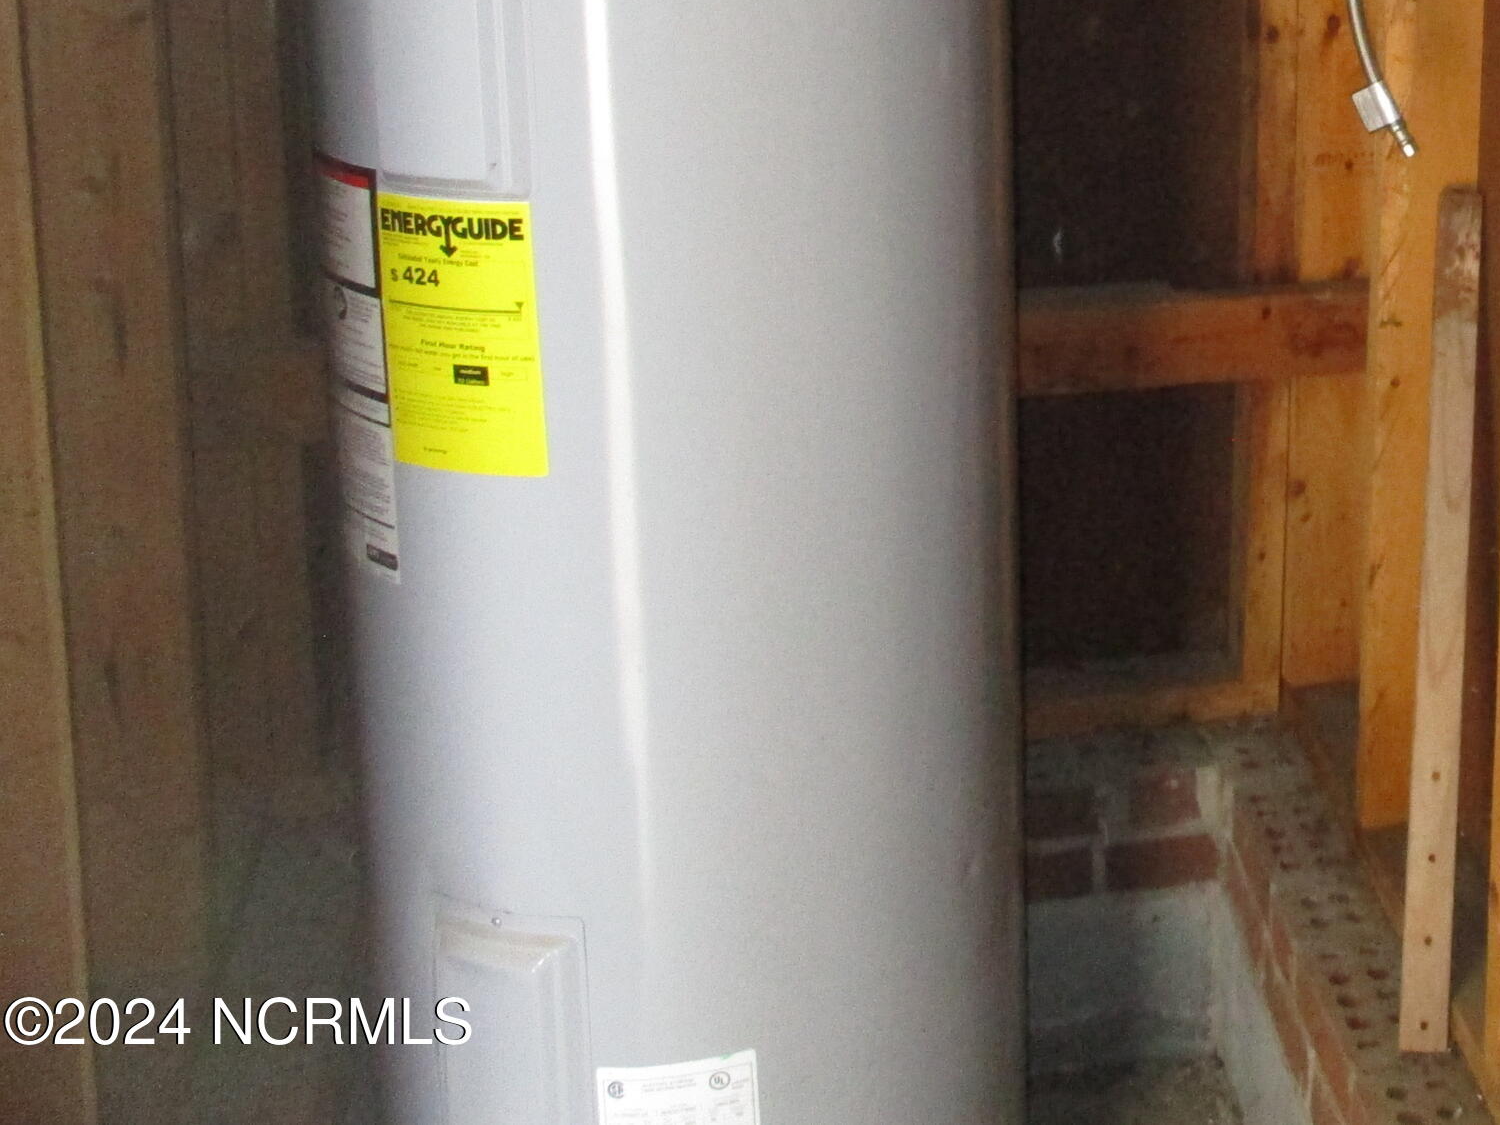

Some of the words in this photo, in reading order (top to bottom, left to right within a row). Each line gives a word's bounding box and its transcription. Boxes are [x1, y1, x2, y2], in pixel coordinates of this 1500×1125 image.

[381, 208, 524, 244] ENERGYGUIDE
[443, 258, 463, 267] Energy
[402, 266, 440, 287] 424
[421, 339, 436, 348] First
[439, 341, 456, 349] Hour
[459, 343, 485, 352] Rating
